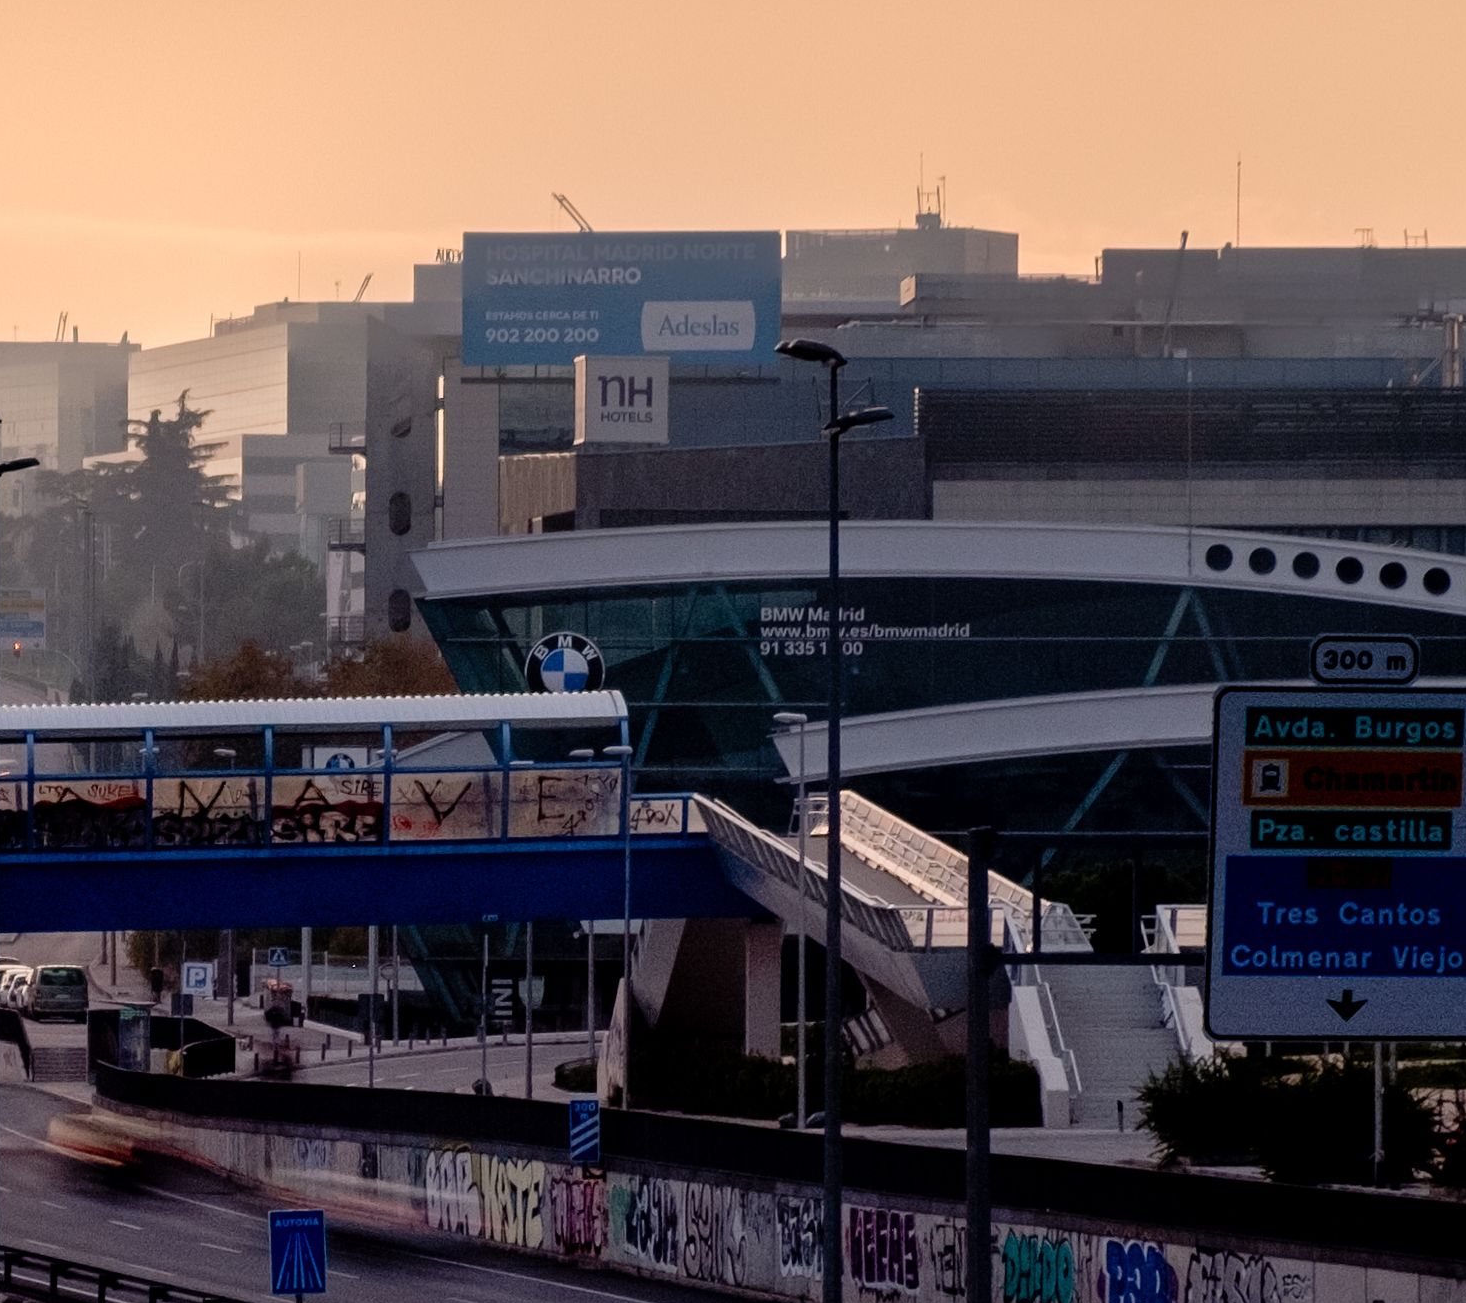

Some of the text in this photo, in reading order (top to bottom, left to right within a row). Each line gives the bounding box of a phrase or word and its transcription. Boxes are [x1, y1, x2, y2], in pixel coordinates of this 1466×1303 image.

[487, 244, 756, 262] HOSPITAL MADRID NORTE
[486, 267, 642, 286] SANCHINARRO
[485, 327, 600, 344] 902 200 200
[658, 314, 740, 337] Adeslas
[600, 411, 653, 423] HOTELS
[760, 606, 805, 623] BMW
[533, 635, 598, 661] BMW
[759, 640, 779, 657] 91
[784, 640, 815, 657] 335
[1323, 649, 1406, 671] 300 m
[1252, 715, 1458, 744] Avda. Burgos
[1257, 819, 1444, 844] Pza. castilla
[1256, 900, 1443, 926] Tres Cantos
[1229, 943, 1465, 974] Colmenar Viejo
